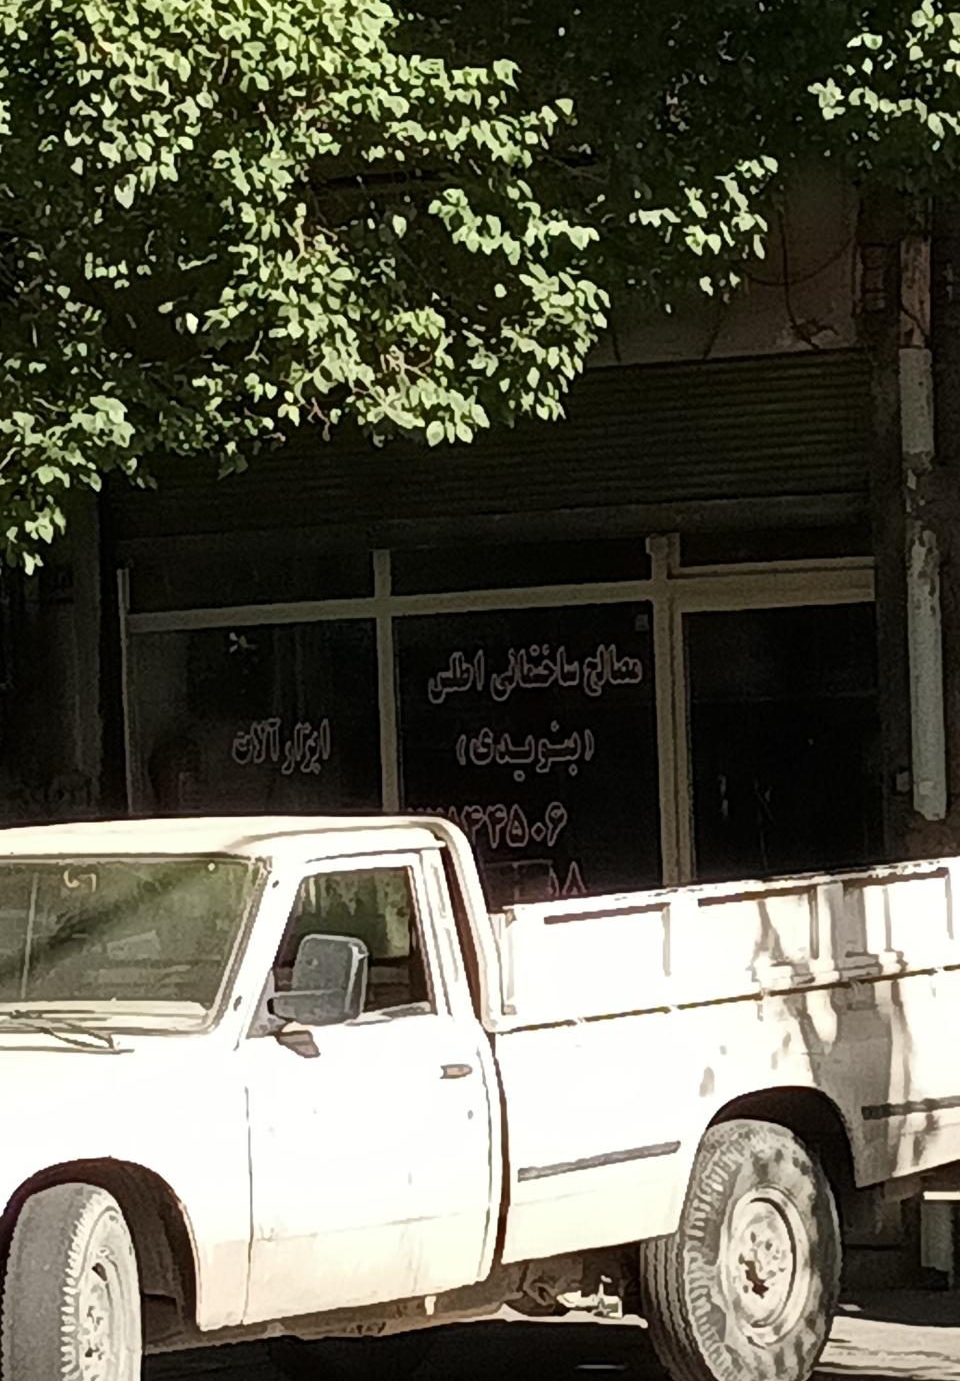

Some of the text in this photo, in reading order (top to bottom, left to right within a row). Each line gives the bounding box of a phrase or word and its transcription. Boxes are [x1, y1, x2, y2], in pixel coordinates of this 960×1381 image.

[427, 643, 643, 705] مصالح ساختمانی اطلس
